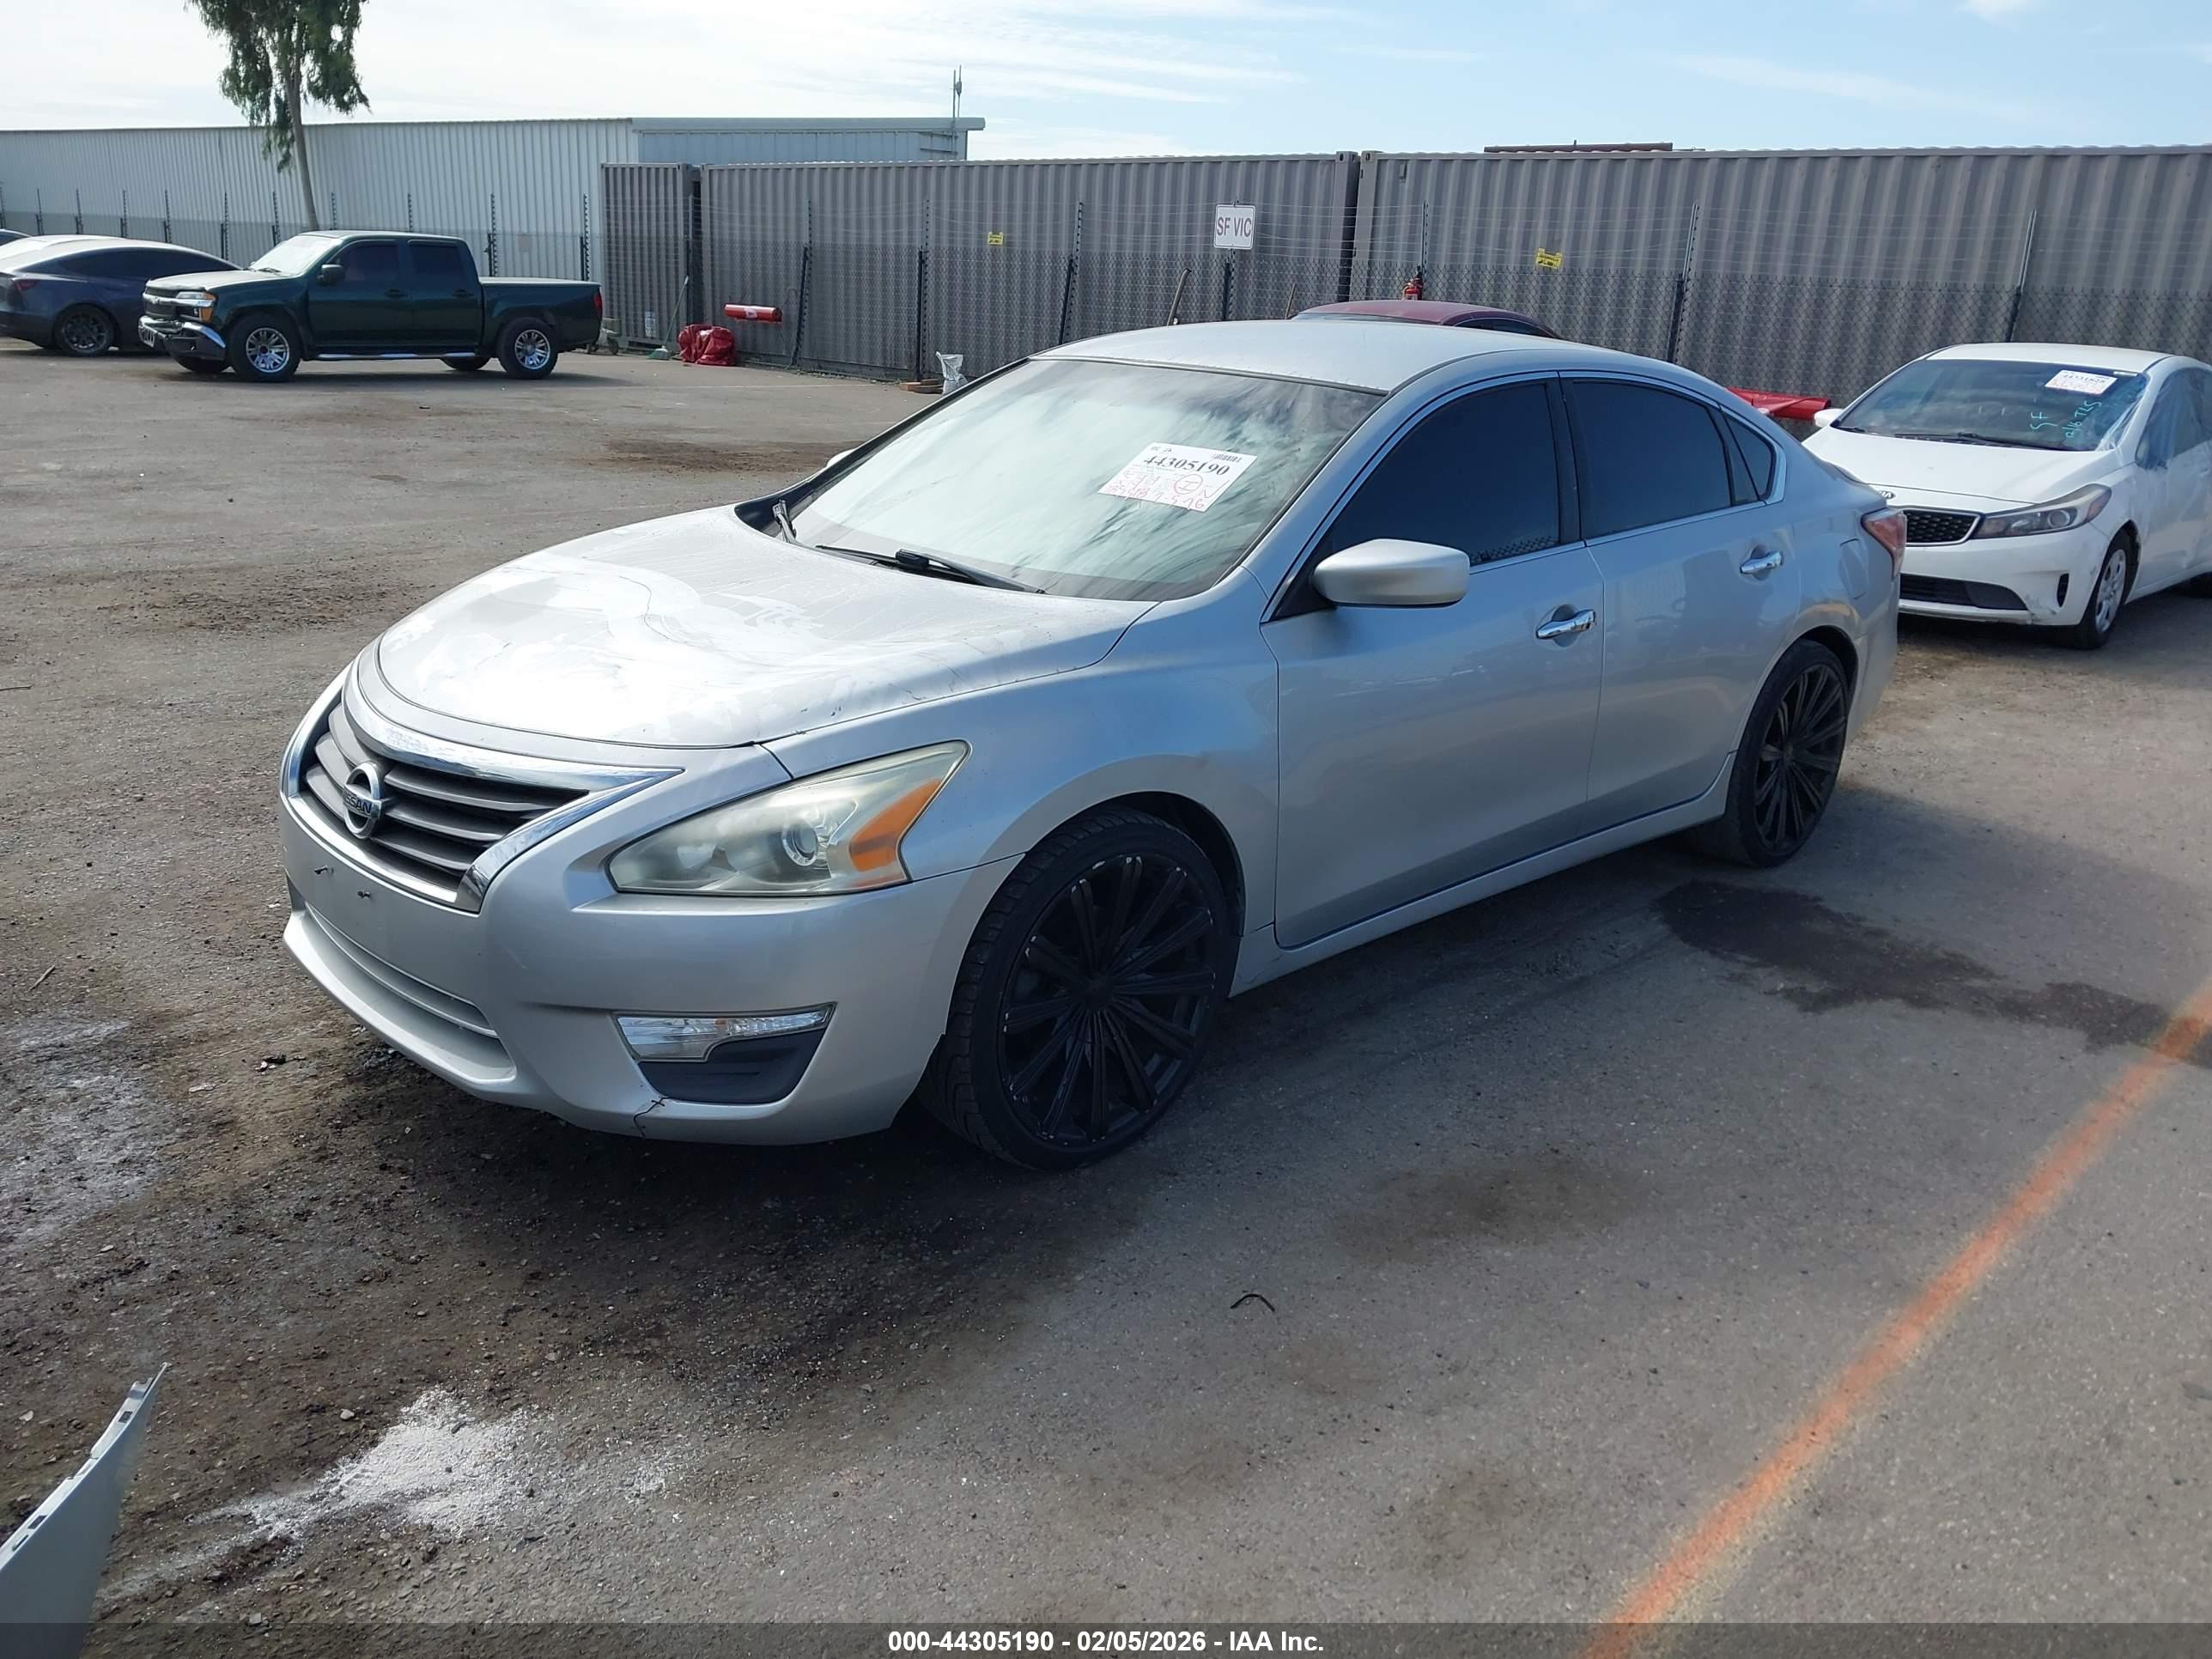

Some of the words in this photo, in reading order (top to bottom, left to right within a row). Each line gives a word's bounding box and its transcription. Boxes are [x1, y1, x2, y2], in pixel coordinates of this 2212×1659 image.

[1216, 216, 1231, 237] SF
[1233, 217, 1253, 238] VIC
[1143, 454, 1231, 476] 44305190
